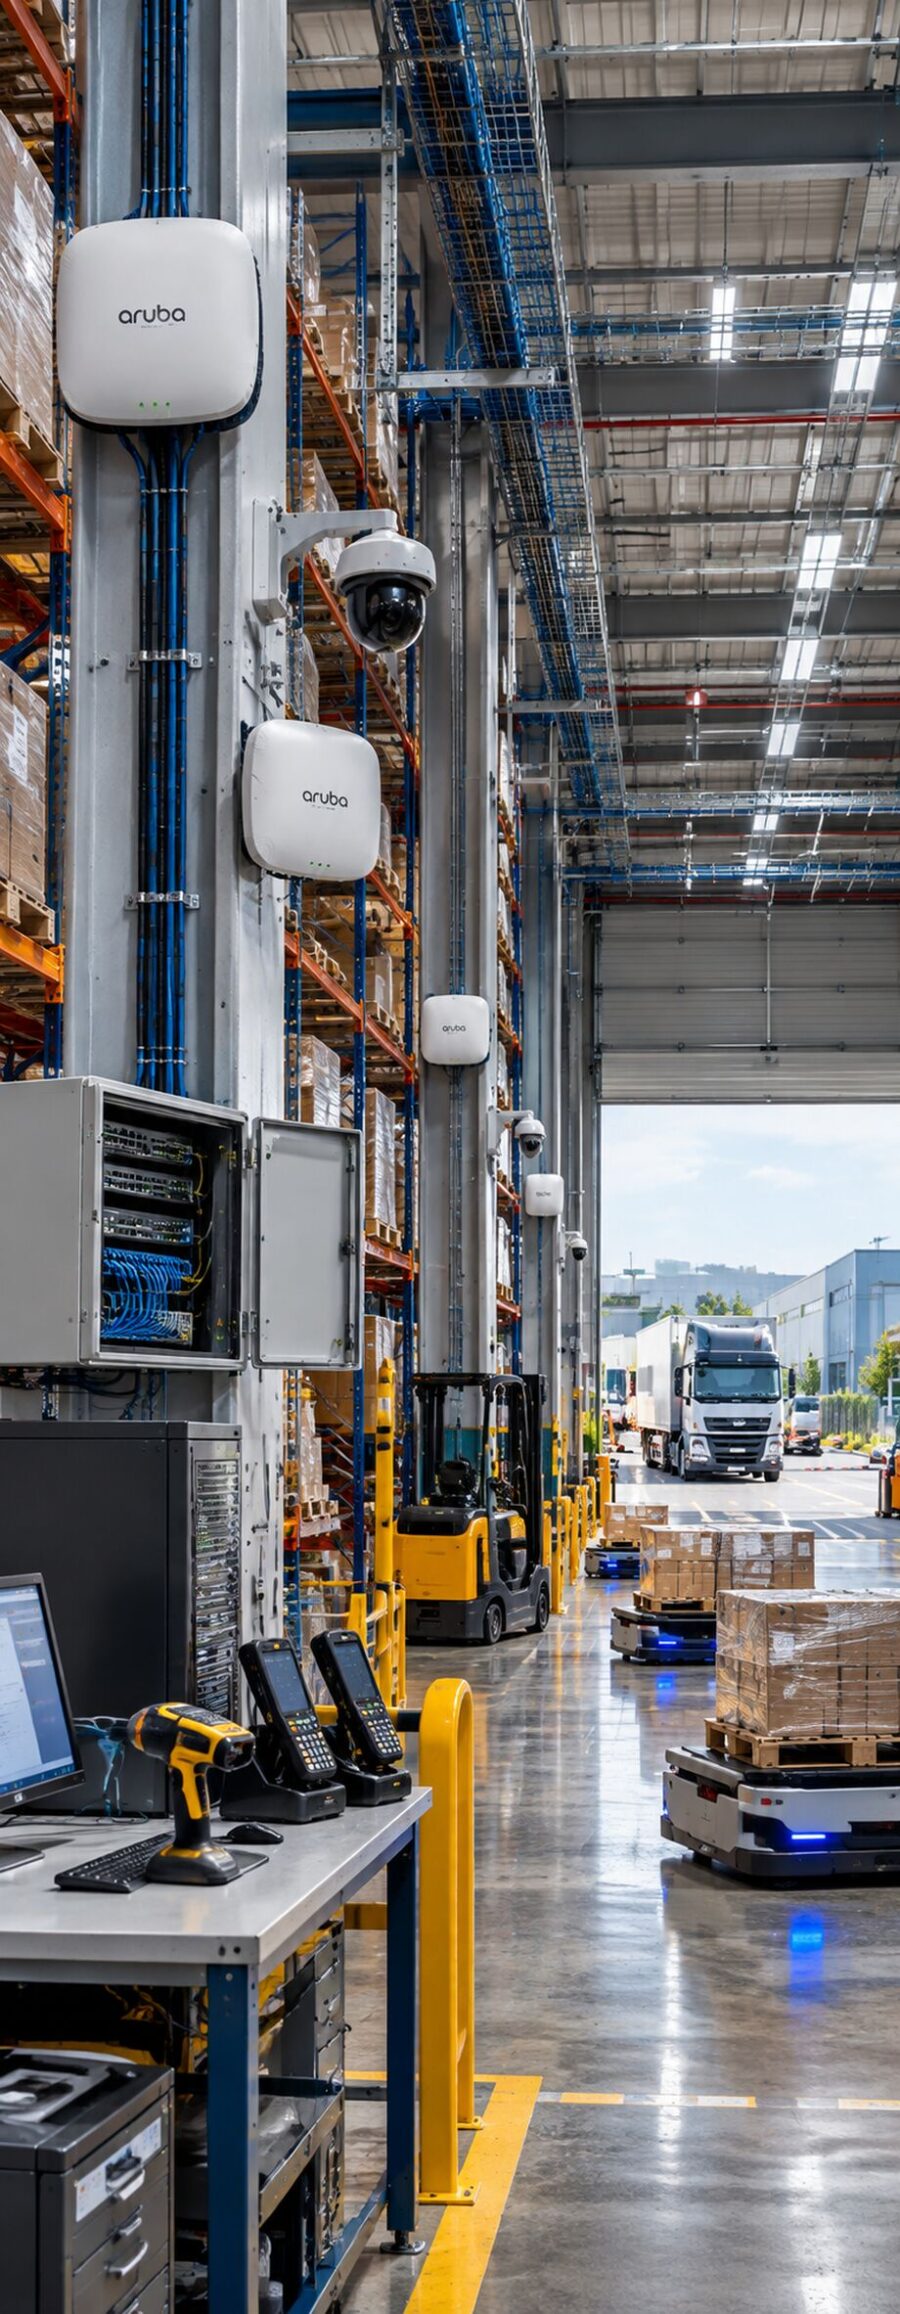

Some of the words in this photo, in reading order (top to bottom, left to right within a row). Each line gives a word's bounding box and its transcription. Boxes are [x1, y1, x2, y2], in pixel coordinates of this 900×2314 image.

[118, 304, 185, 324] aruba
[302, 790, 348, 807] aruba
[442, 1024, 466, 1032] aruba
